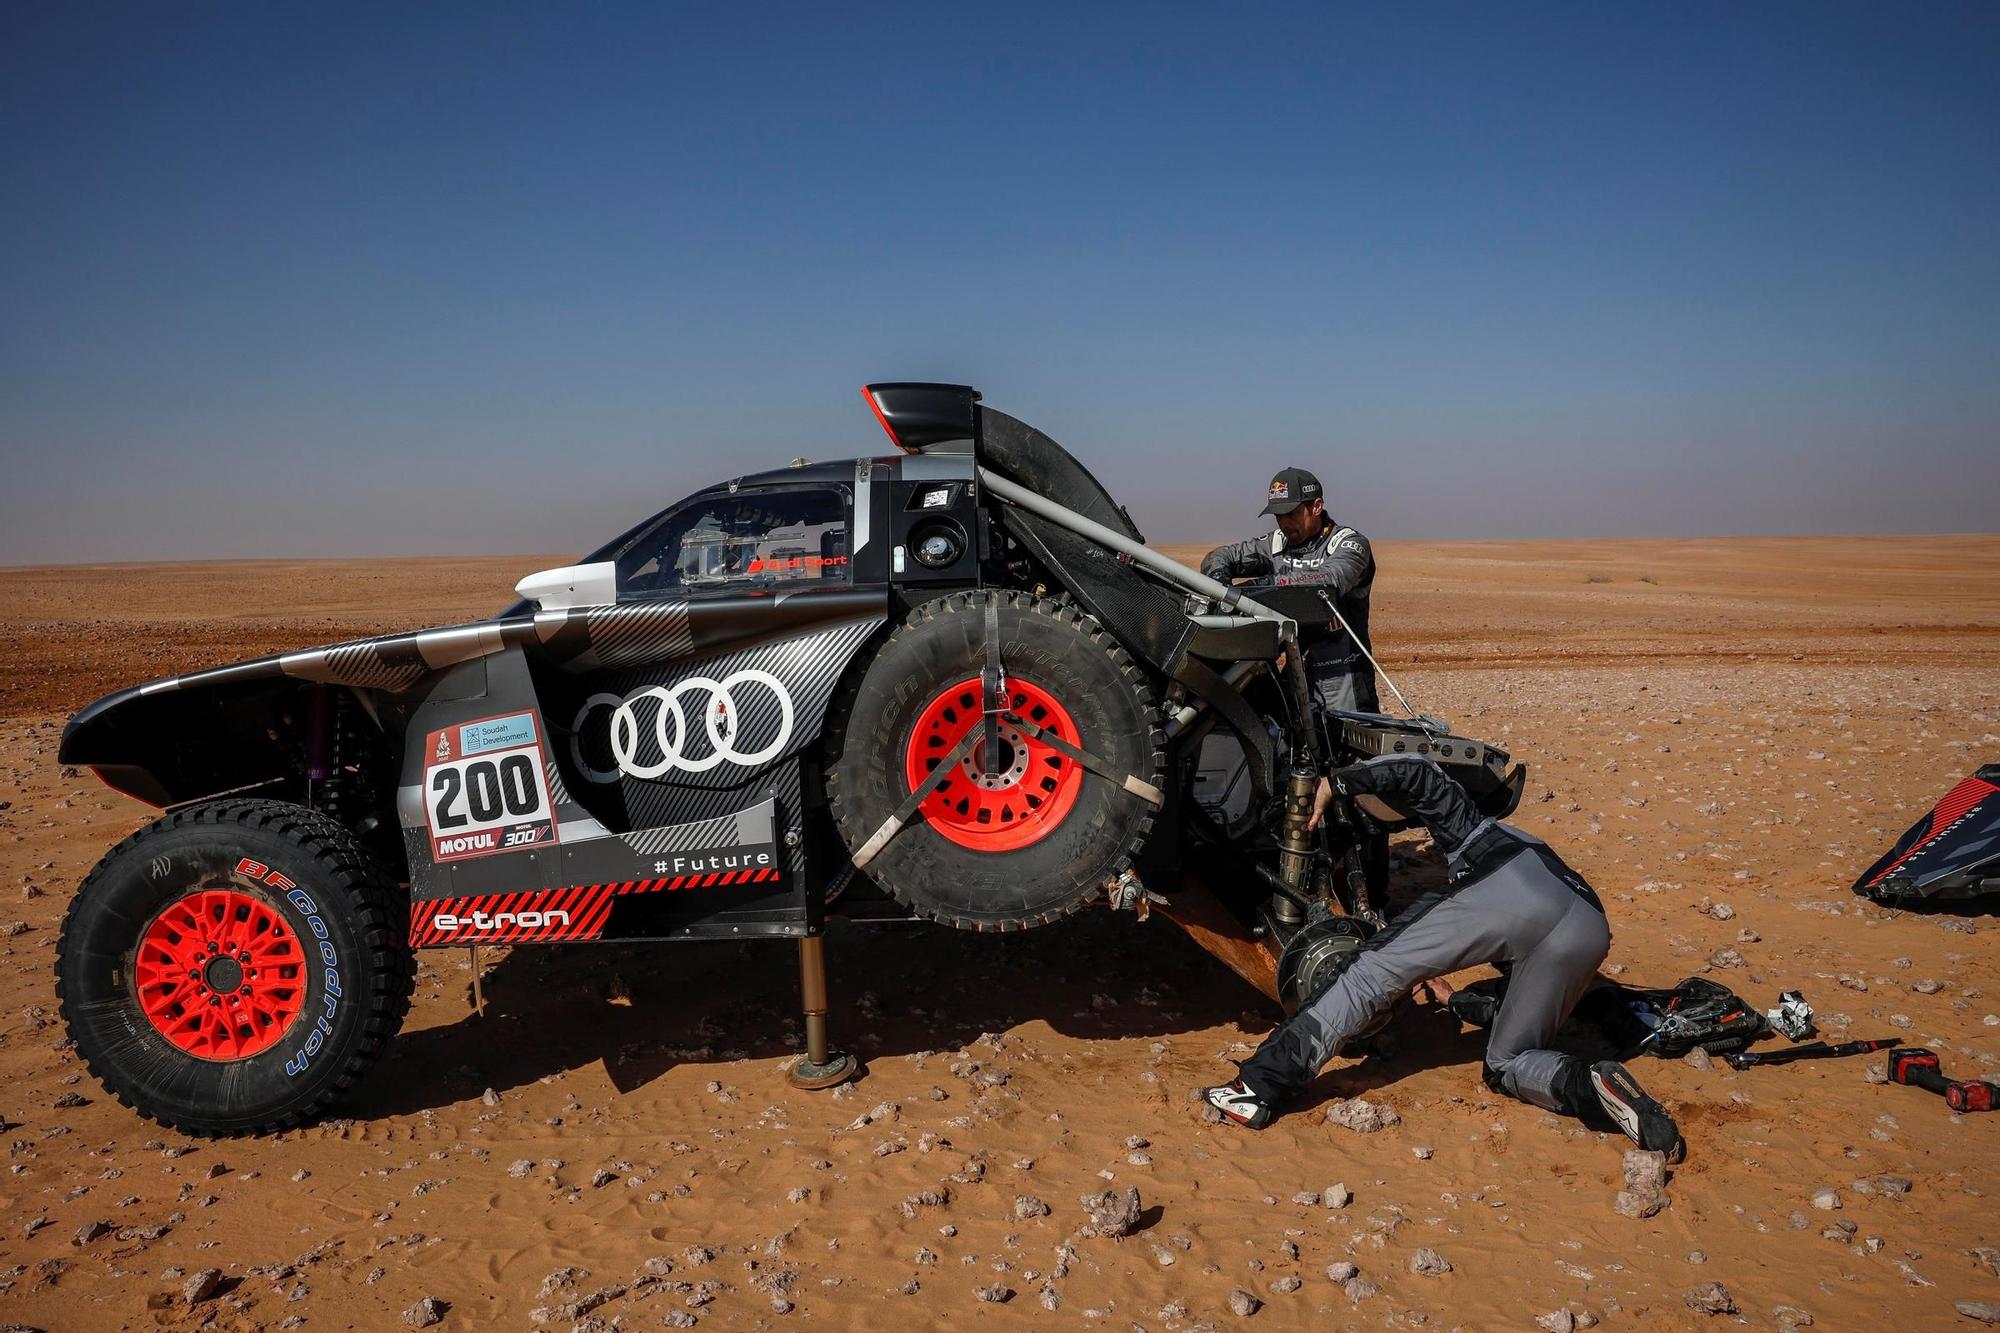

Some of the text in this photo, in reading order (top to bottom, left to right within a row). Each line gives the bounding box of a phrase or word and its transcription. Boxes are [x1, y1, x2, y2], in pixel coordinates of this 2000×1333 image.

[804, 555, 848, 568] Sport
[481, 724, 509, 736] Soudah
[482, 731, 529, 746] Development
[433, 754, 540, 830] 200
[440, 833, 495, 855] MOTUL
[504, 825, 551, 847] 300V
[152, 856, 171, 880] AD
[654, 851, 770, 874] #Future
[433, 909, 570, 931] e-tron
[235, 857, 342, 1076] BFGoodrich
